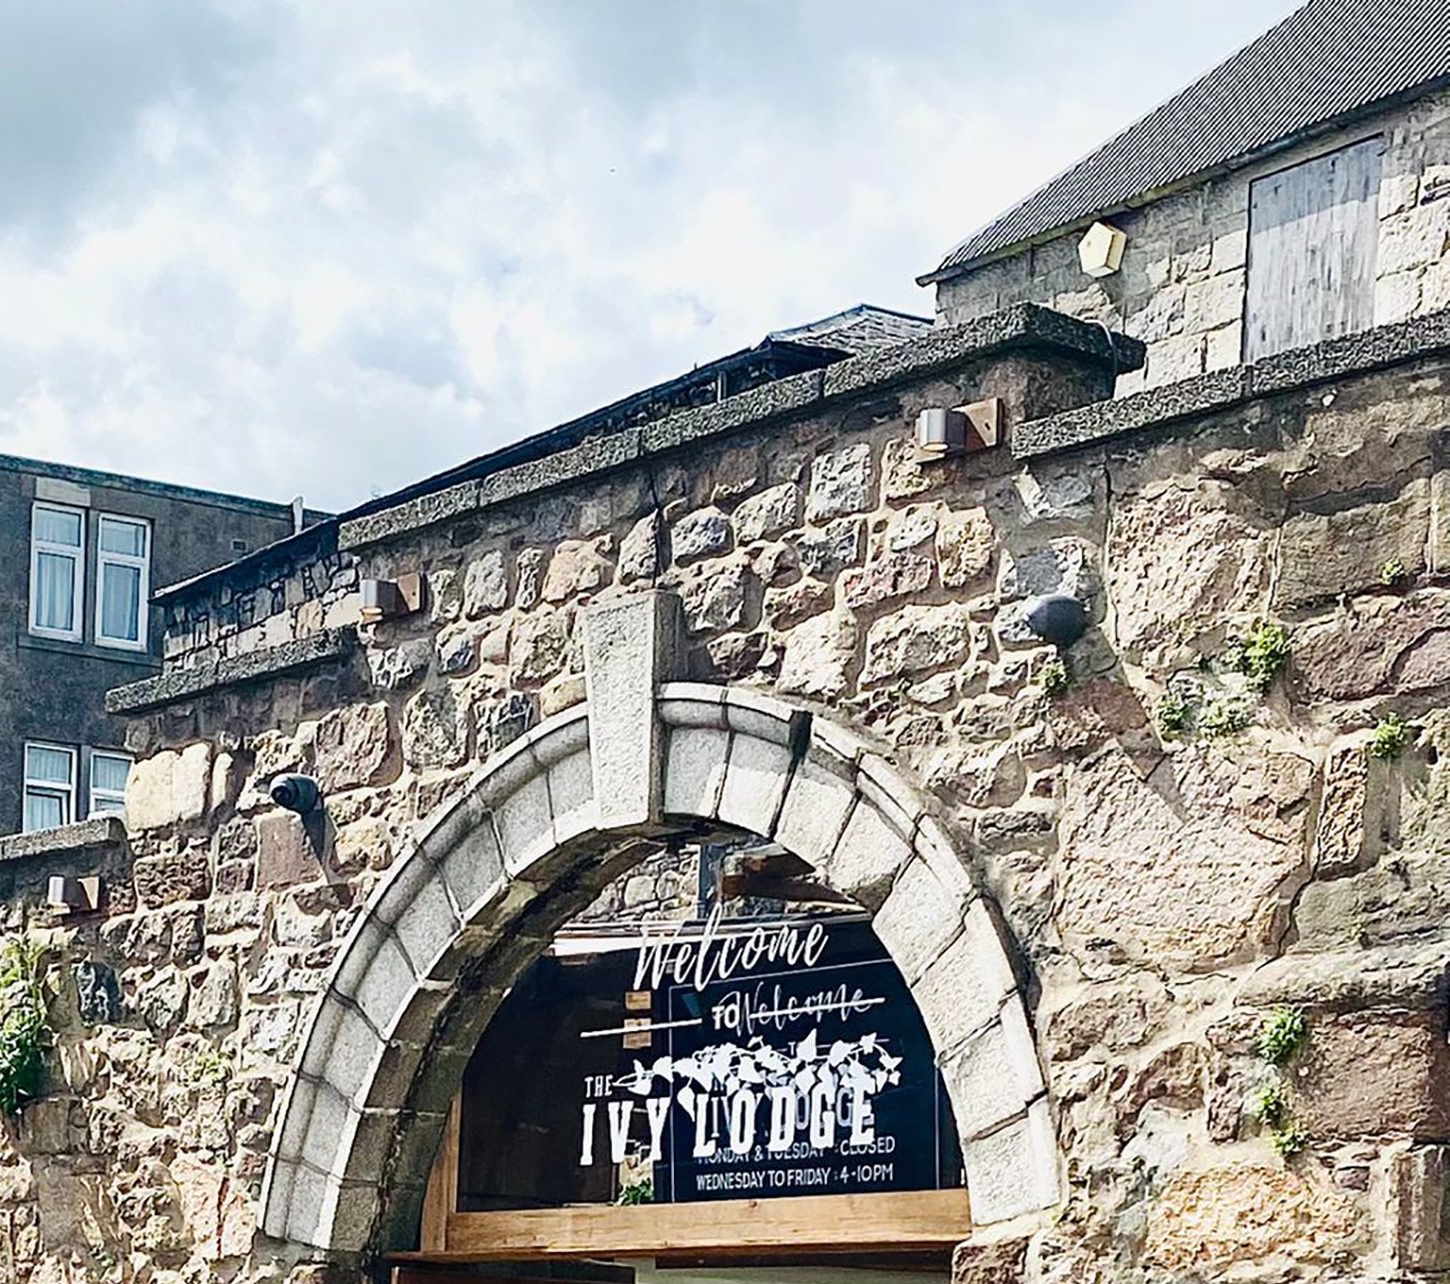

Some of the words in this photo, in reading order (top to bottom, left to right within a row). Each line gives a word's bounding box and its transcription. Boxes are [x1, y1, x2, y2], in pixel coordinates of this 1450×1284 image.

[633, 903, 829, 992] Welcome
[711, 1004, 740, 1030] TO
[584, 1074, 613, 1098] THE
[580, 1097, 671, 1166] IVY
[693, 1080, 875, 1158] LODGE
[696, 1170, 766, 1191] WEDNESDAY
[767, 1169, 786, 1187] TO
[787, 1166, 831, 1186] FRIDAY
